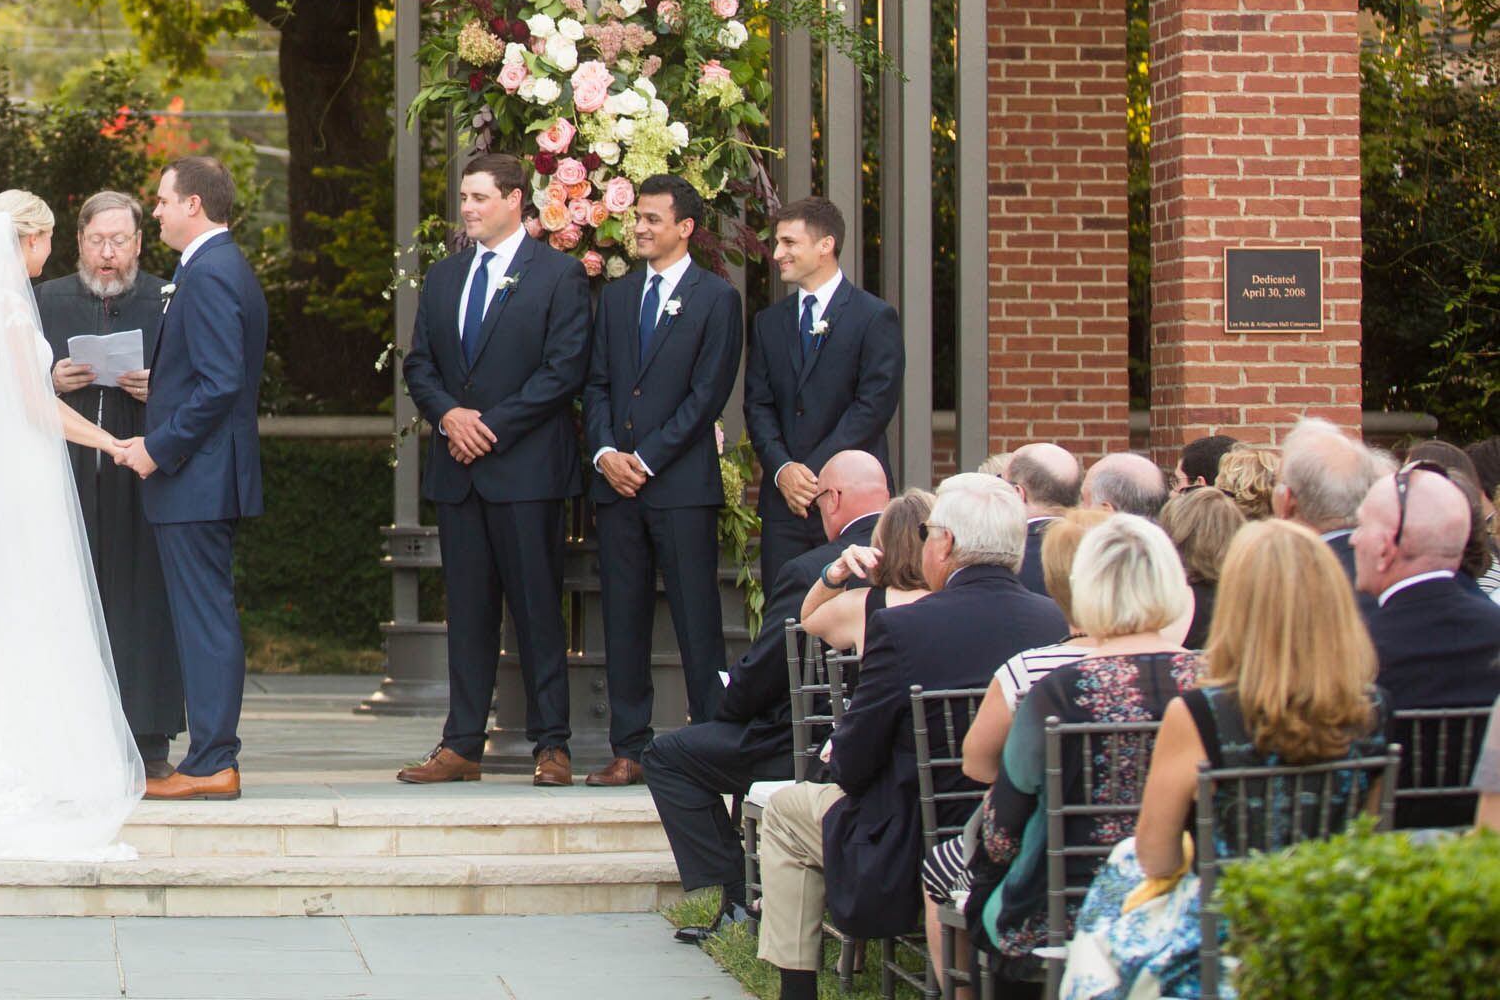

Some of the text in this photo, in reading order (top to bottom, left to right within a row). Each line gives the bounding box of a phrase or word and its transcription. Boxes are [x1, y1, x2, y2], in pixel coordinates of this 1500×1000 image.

[1251, 274, 1296, 285] Dedicated
[1242, 287, 1306, 299] April 30, 2008
